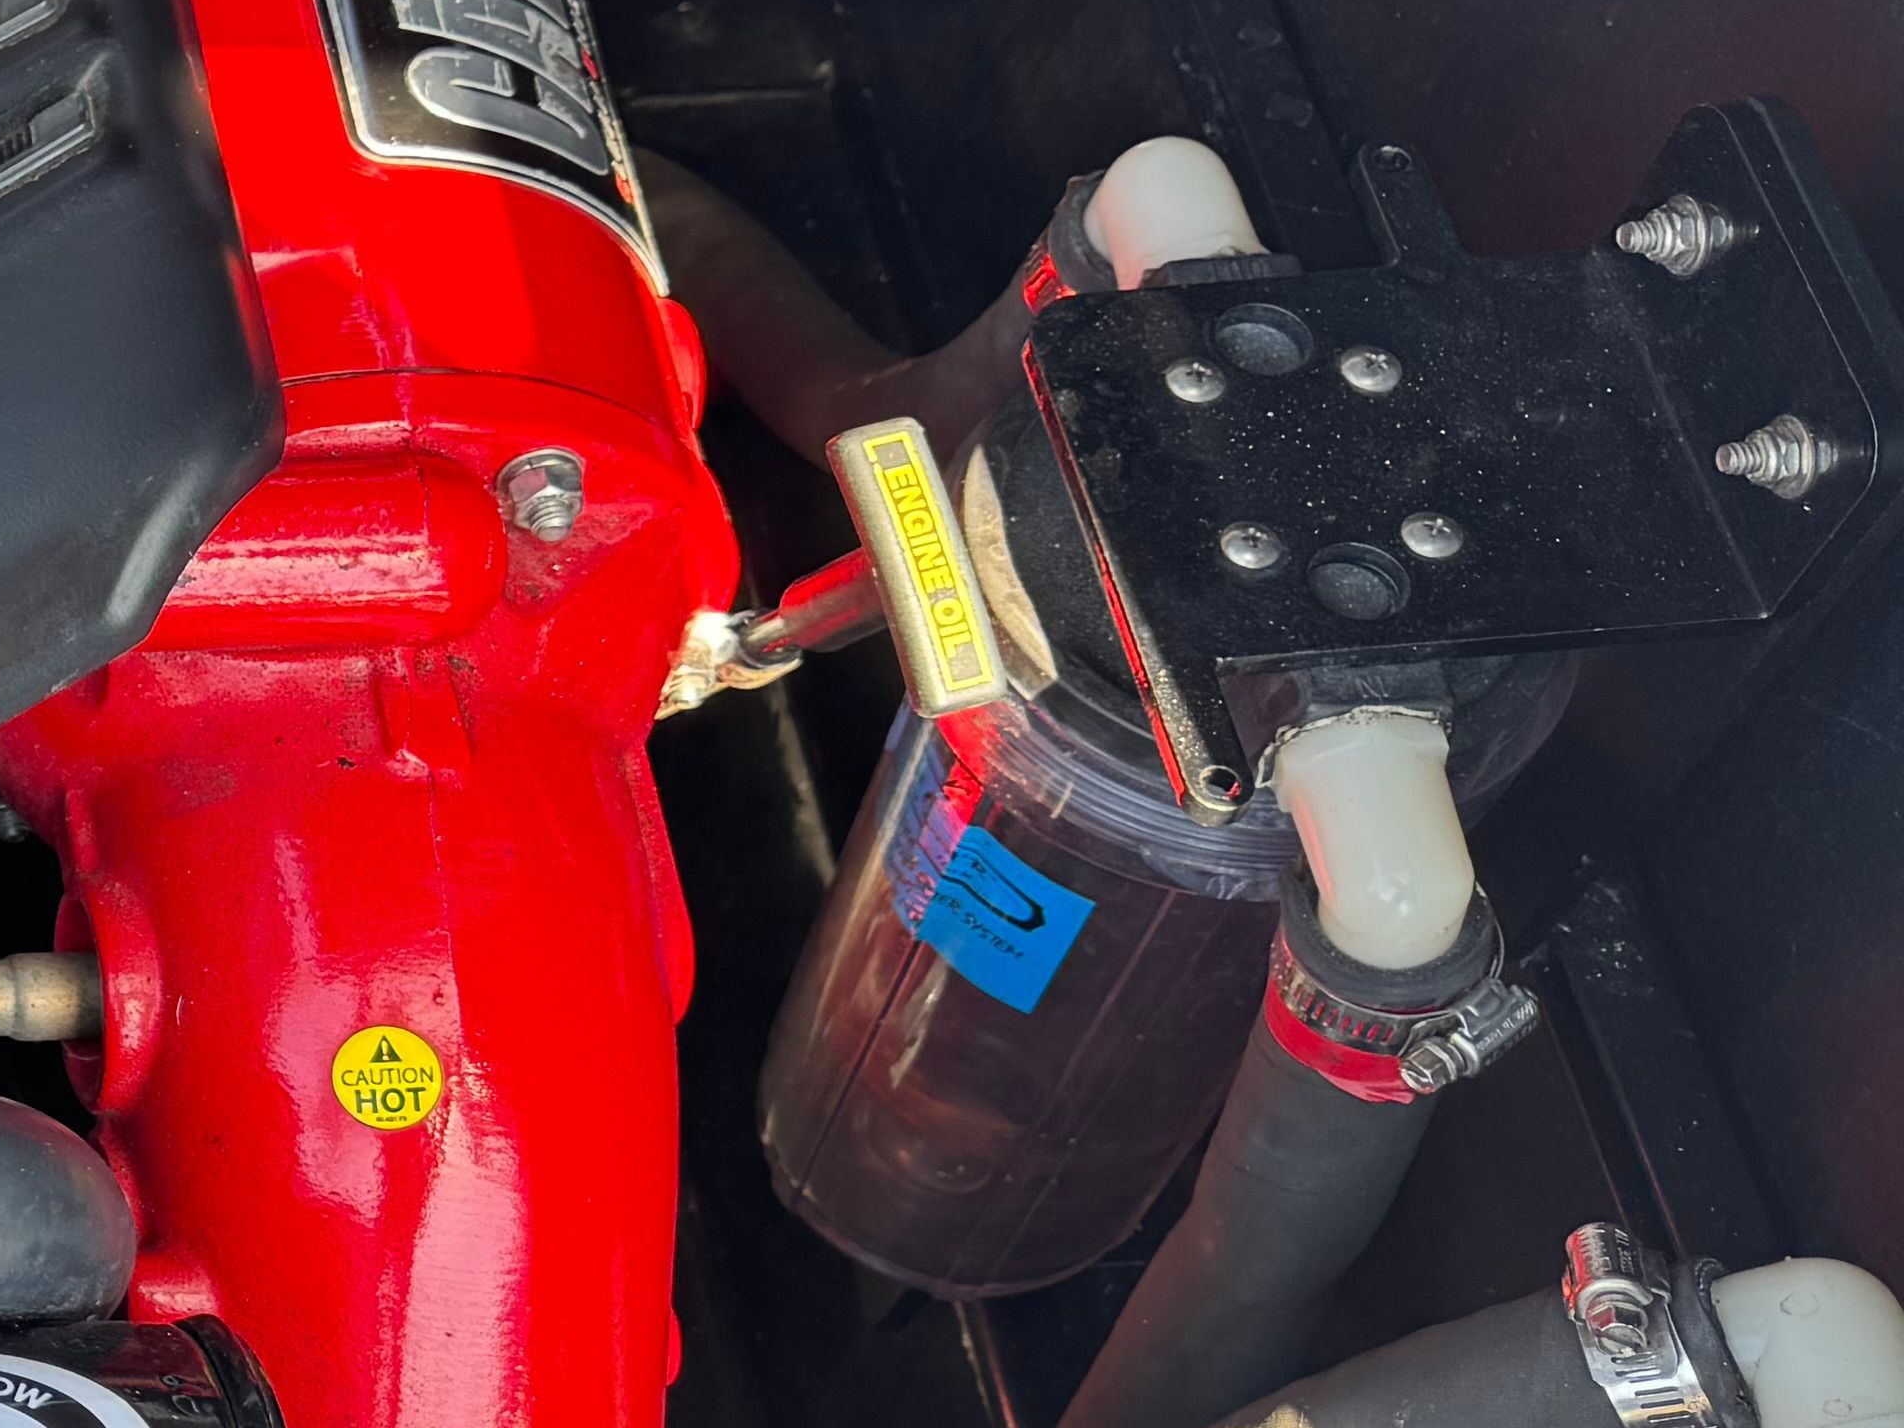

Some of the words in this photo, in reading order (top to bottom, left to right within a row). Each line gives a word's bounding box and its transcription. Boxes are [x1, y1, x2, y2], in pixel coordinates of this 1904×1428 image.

[884, 463, 955, 594] ENGINE
[933, 598, 974, 659] OIL
[341, 1066, 435, 1087] CAUTION
[355, 1086, 427, 1115] HOT
